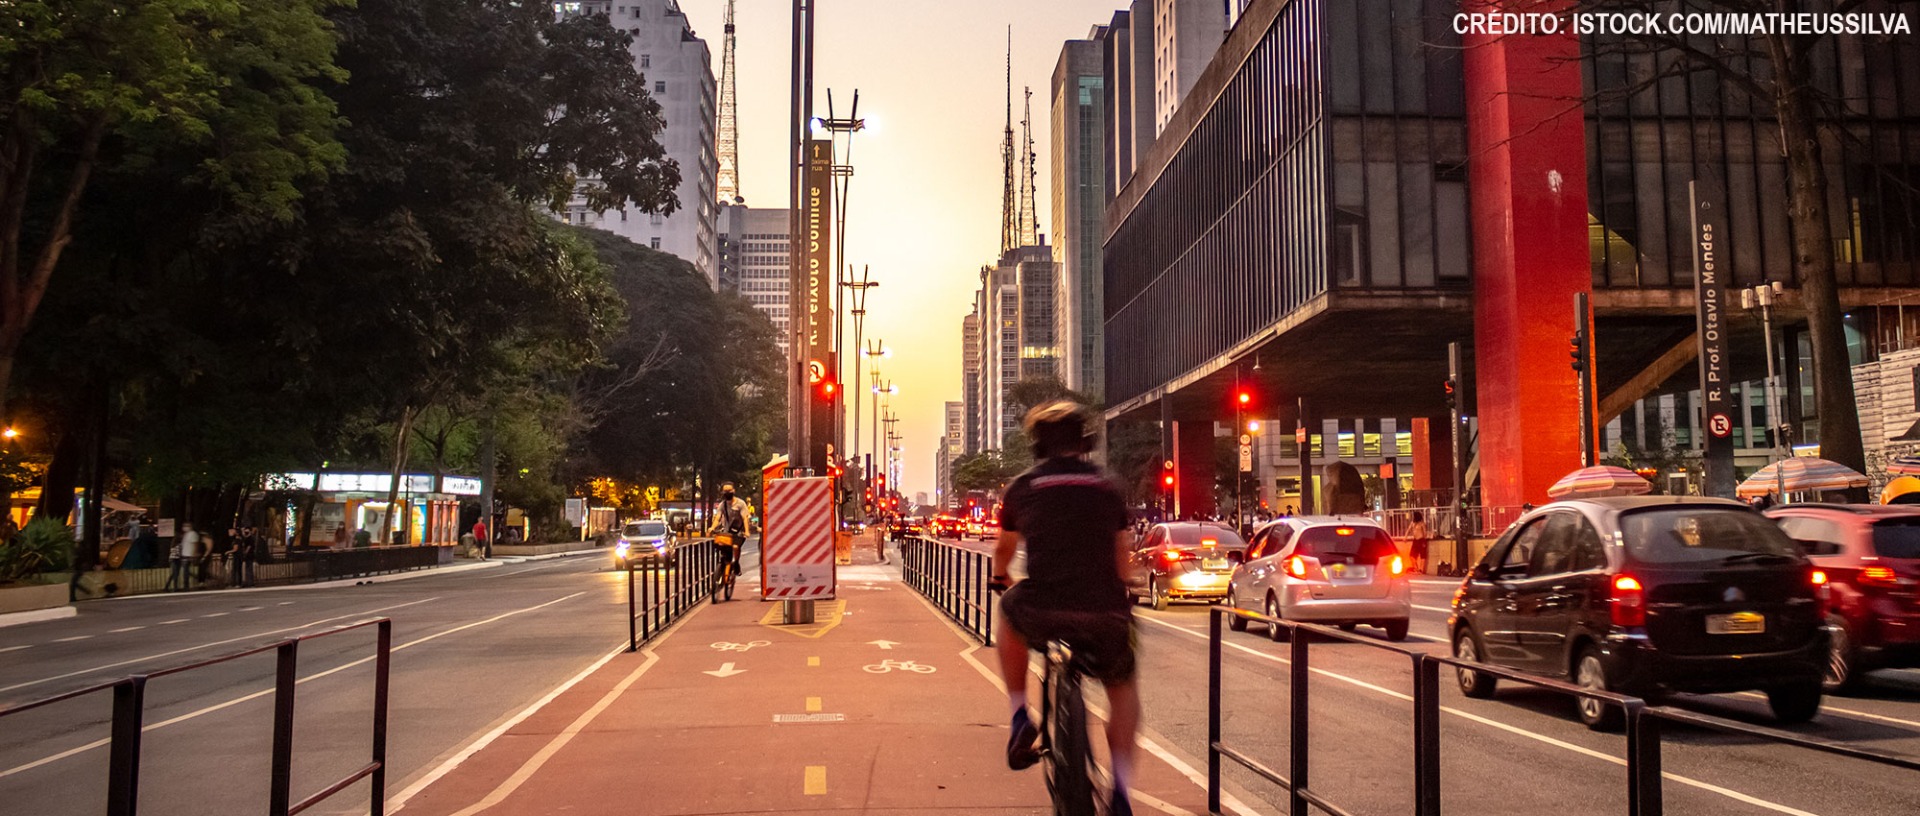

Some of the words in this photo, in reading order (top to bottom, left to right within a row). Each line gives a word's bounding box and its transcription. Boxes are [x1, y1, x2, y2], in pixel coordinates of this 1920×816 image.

[1701, 223, 1715, 284] Mendes
[1704, 288, 1719, 341] Otavio
[1707, 344, 1720, 382] Prof.
[1709, 387, 1721, 402] R.
